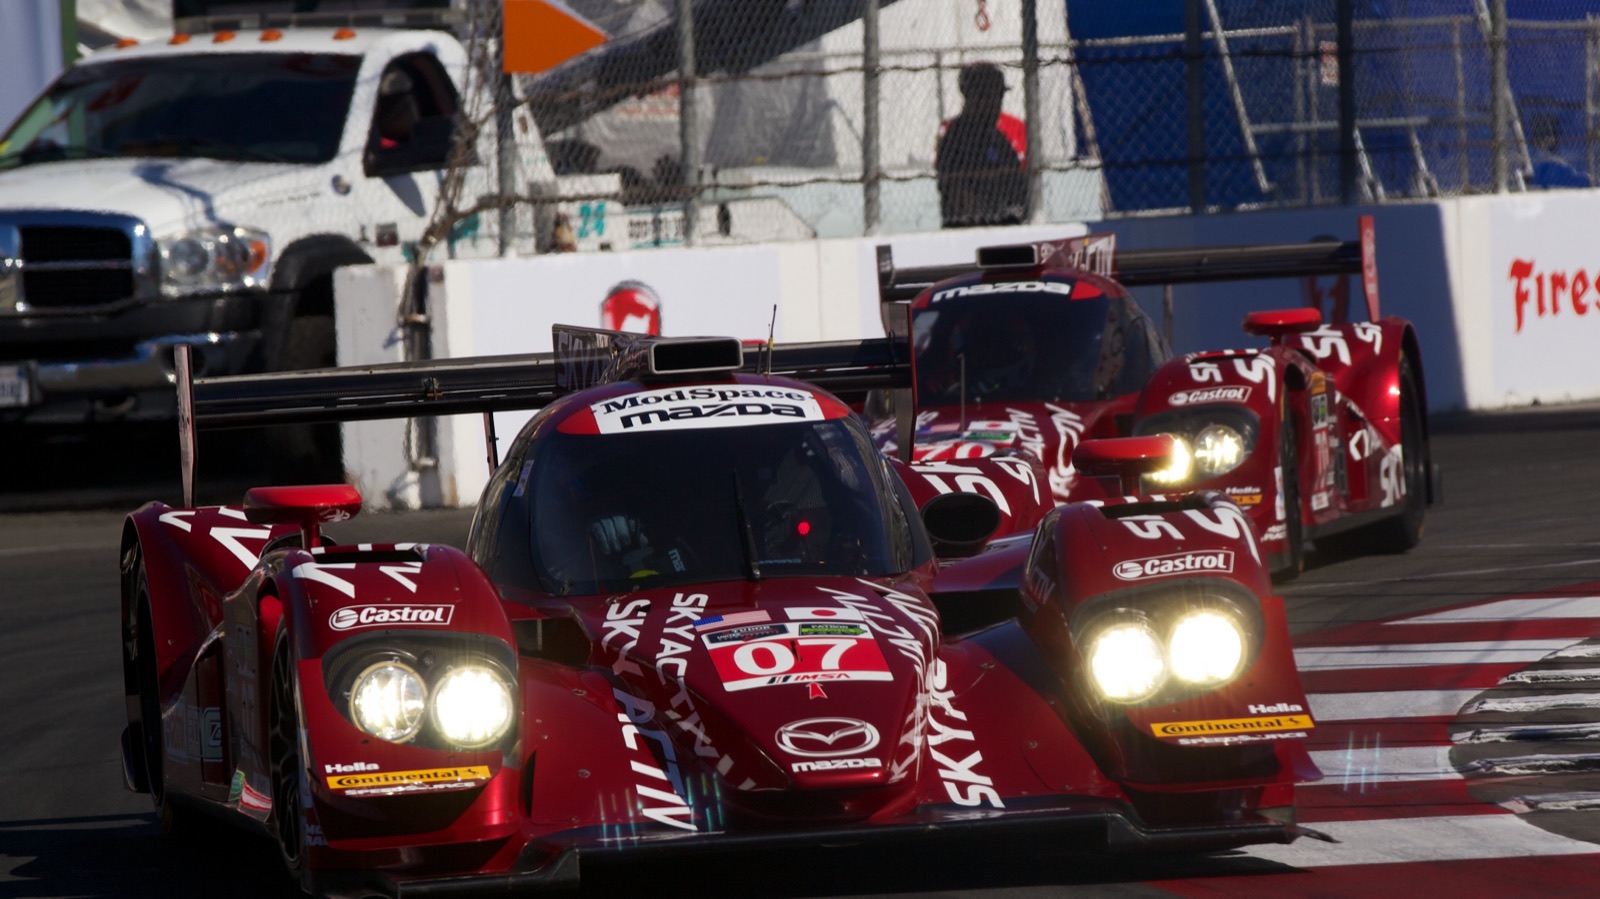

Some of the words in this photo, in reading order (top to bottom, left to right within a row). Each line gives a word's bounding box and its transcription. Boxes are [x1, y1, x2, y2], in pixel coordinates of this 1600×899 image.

[932, 281, 1071, 302] mazda
[603, 387, 806, 414] ModSpace
[1189, 387, 1244, 403] Castrol
[620, 402, 806, 429] mazda
[1225, 486, 1261, 495] Hella
[1144, 553, 1227, 575] Castrol
[359, 607, 444, 624] Castrol
[733, 639, 858, 676] 07
[794, 673, 851, 682] IMSA
[1248, 703, 1302, 714] Hella
[1162, 718, 1283, 735] Continental
[325, 762, 380, 774] Hella
[791, 758, 882, 773] mazda
[337, 770, 460, 787] Continental
